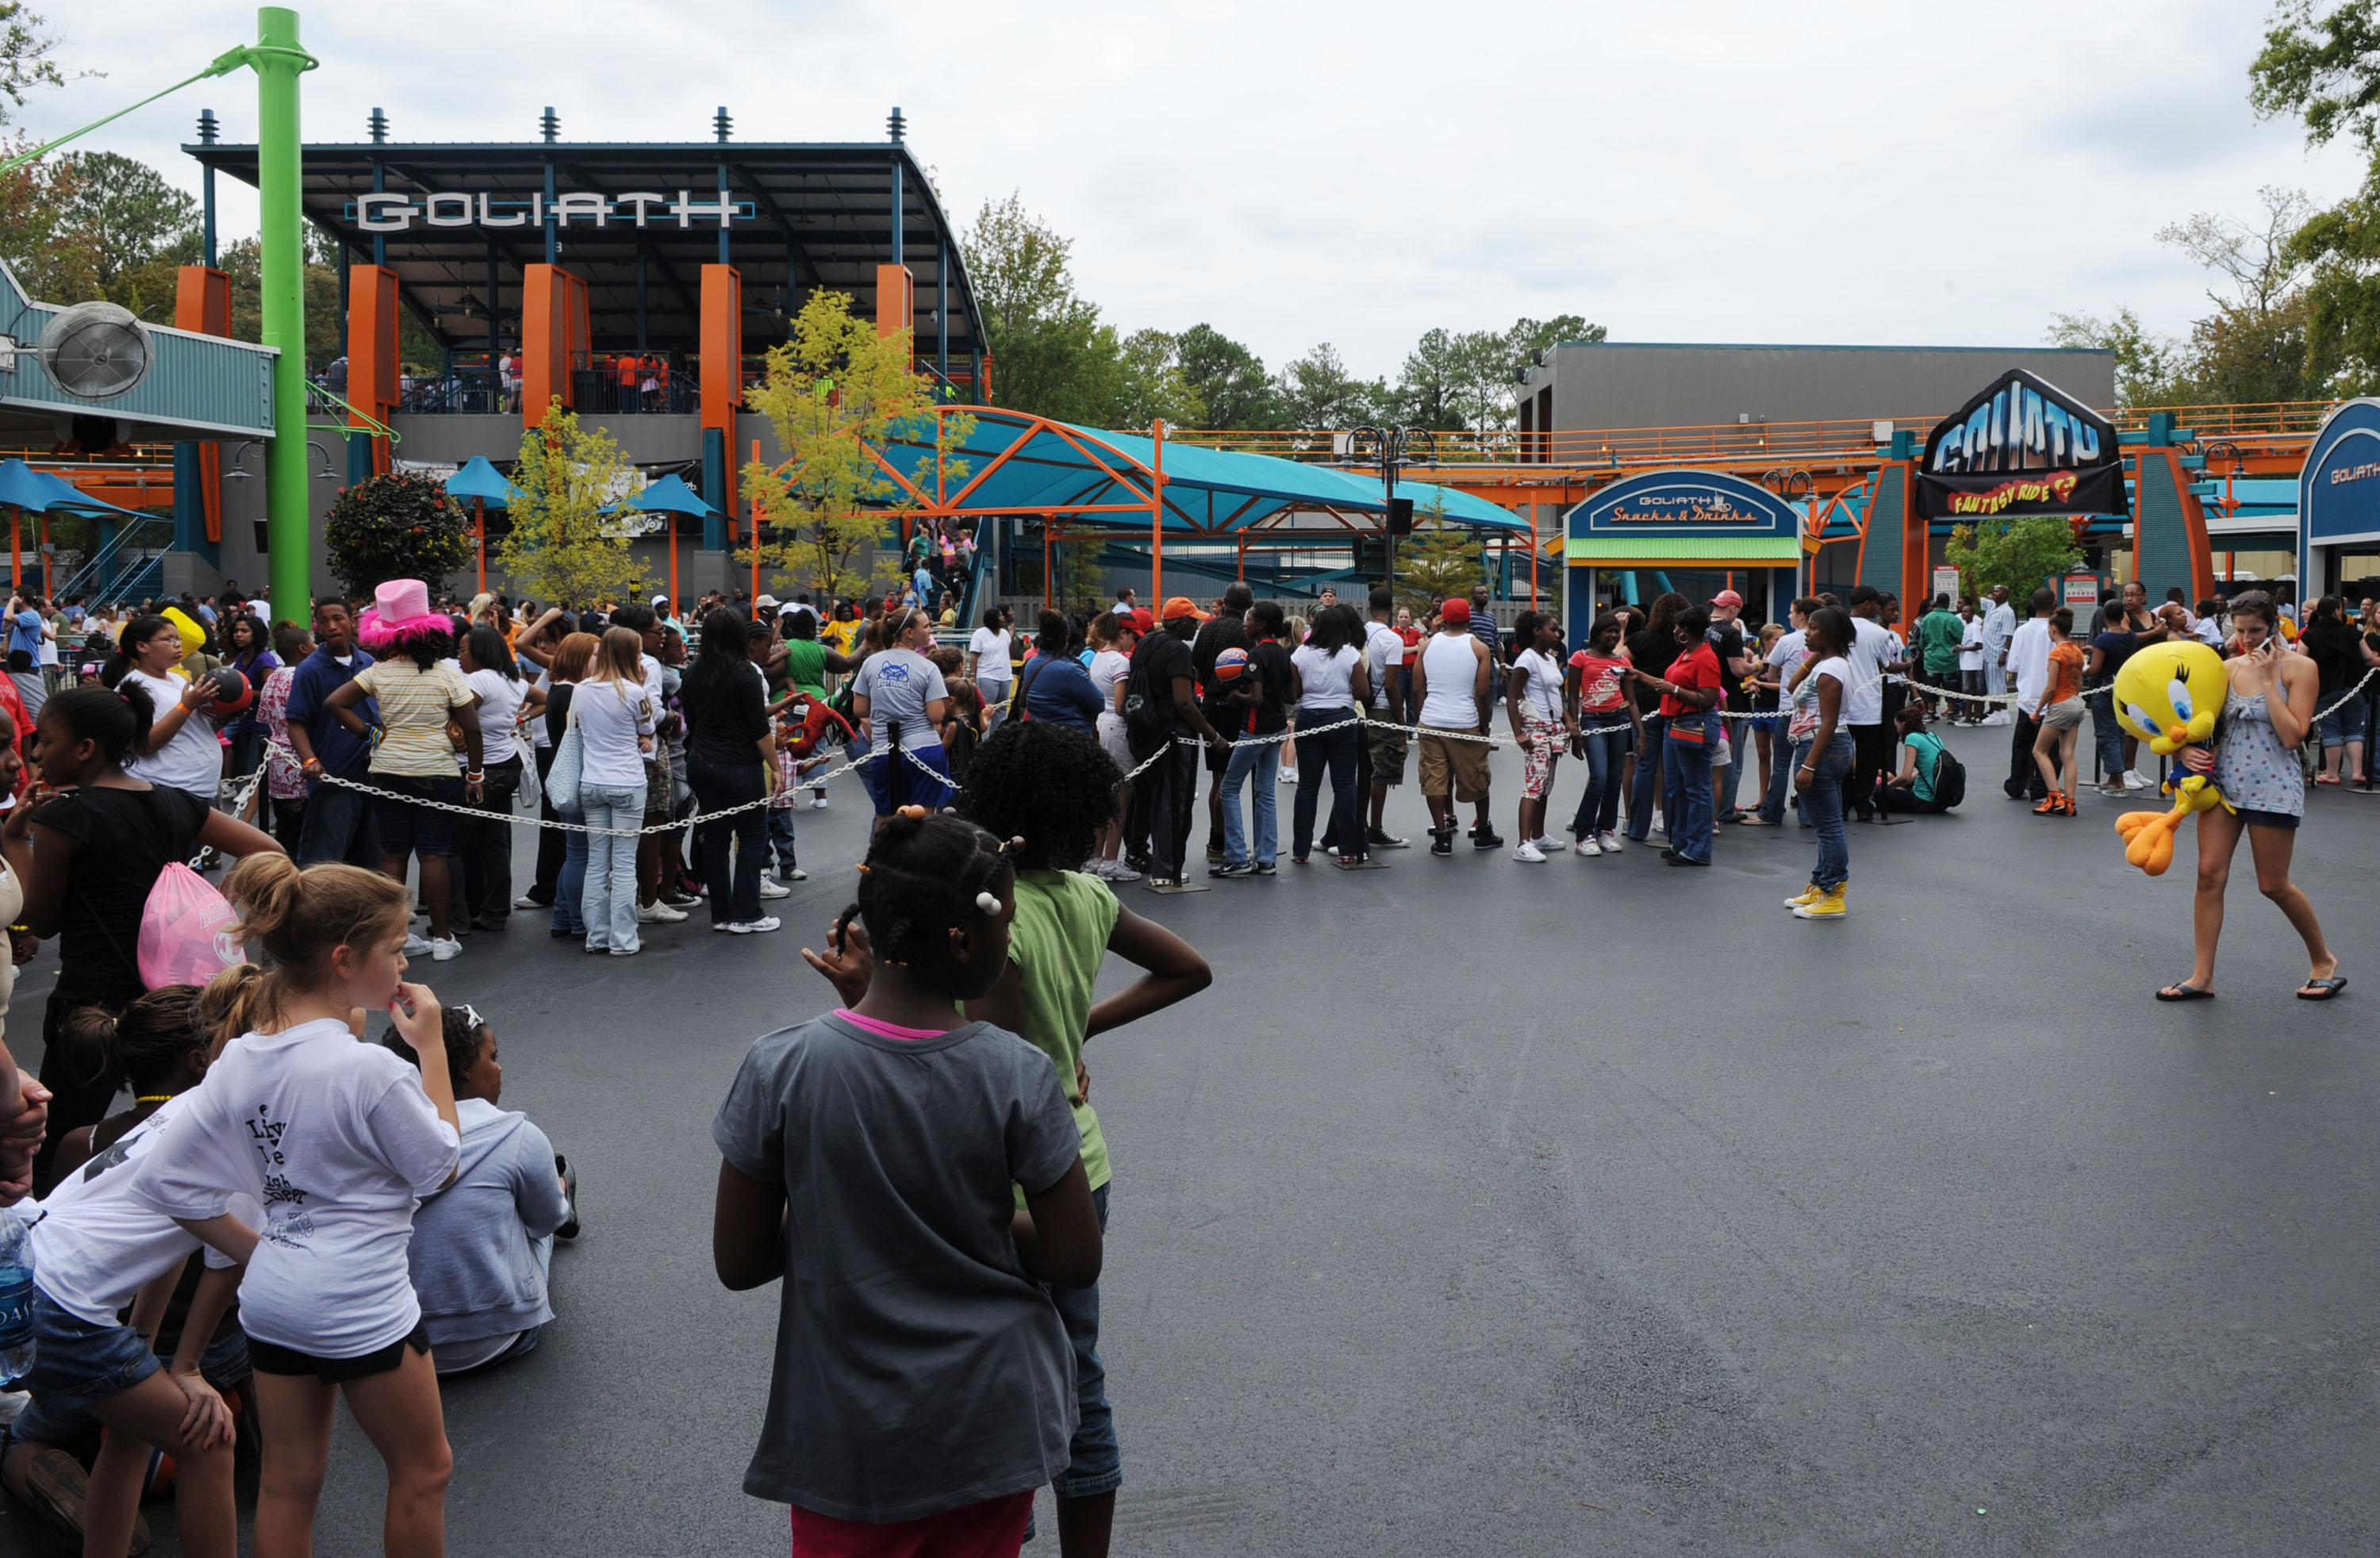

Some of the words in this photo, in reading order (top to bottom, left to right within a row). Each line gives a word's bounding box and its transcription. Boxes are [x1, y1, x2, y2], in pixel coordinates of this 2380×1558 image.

[356, 190, 740, 232] GOLIATH
[1639, 497, 1711, 505] GOLIATH
[1954, 485, 2015, 514] FANTASY
[2017, 482, 2050, 503] RIDE
[1610, 505, 1676, 522] Snacks
[1678, 510, 1688, 522] &
[1690, 504, 1757, 522] Drinks
